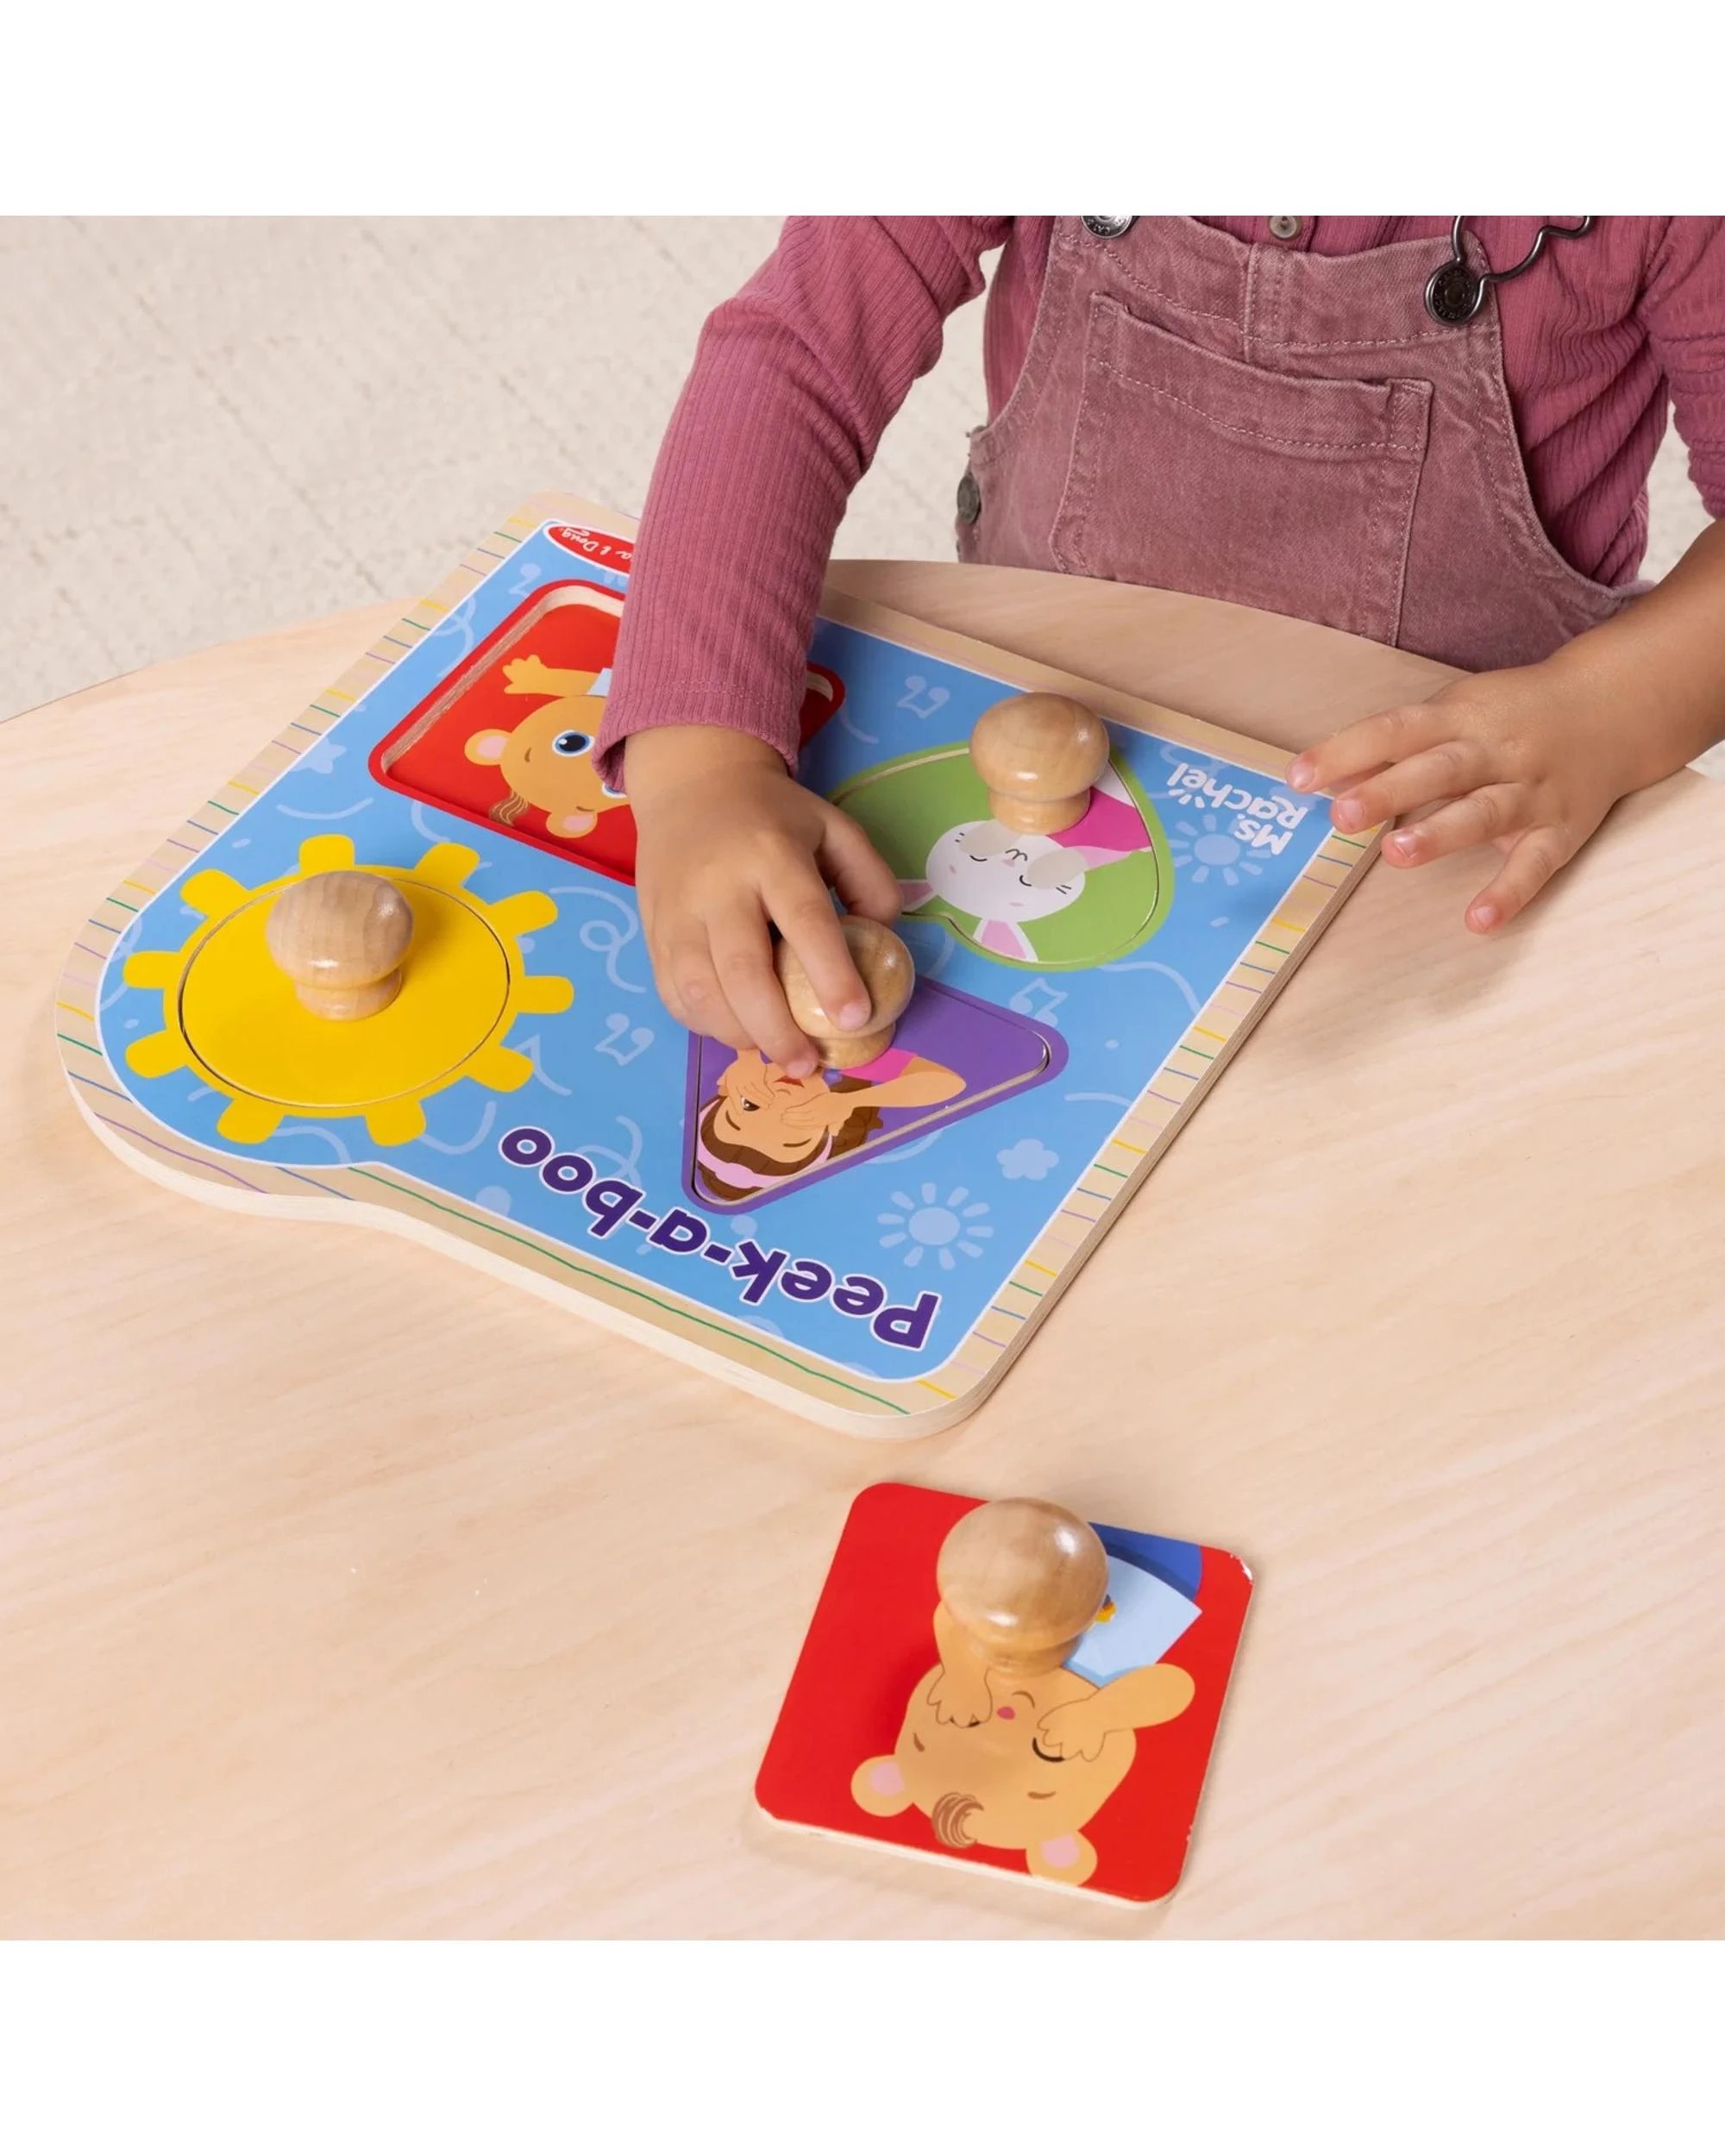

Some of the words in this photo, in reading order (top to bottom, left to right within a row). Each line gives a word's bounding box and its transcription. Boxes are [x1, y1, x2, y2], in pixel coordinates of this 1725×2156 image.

[561, 526, 600, 553] Doug
[1166, 762, 1309, 830] Rachel
[1233, 813, 1294, 856] Ms.
[499, 1127, 942, 1351] Peek-a-boo
